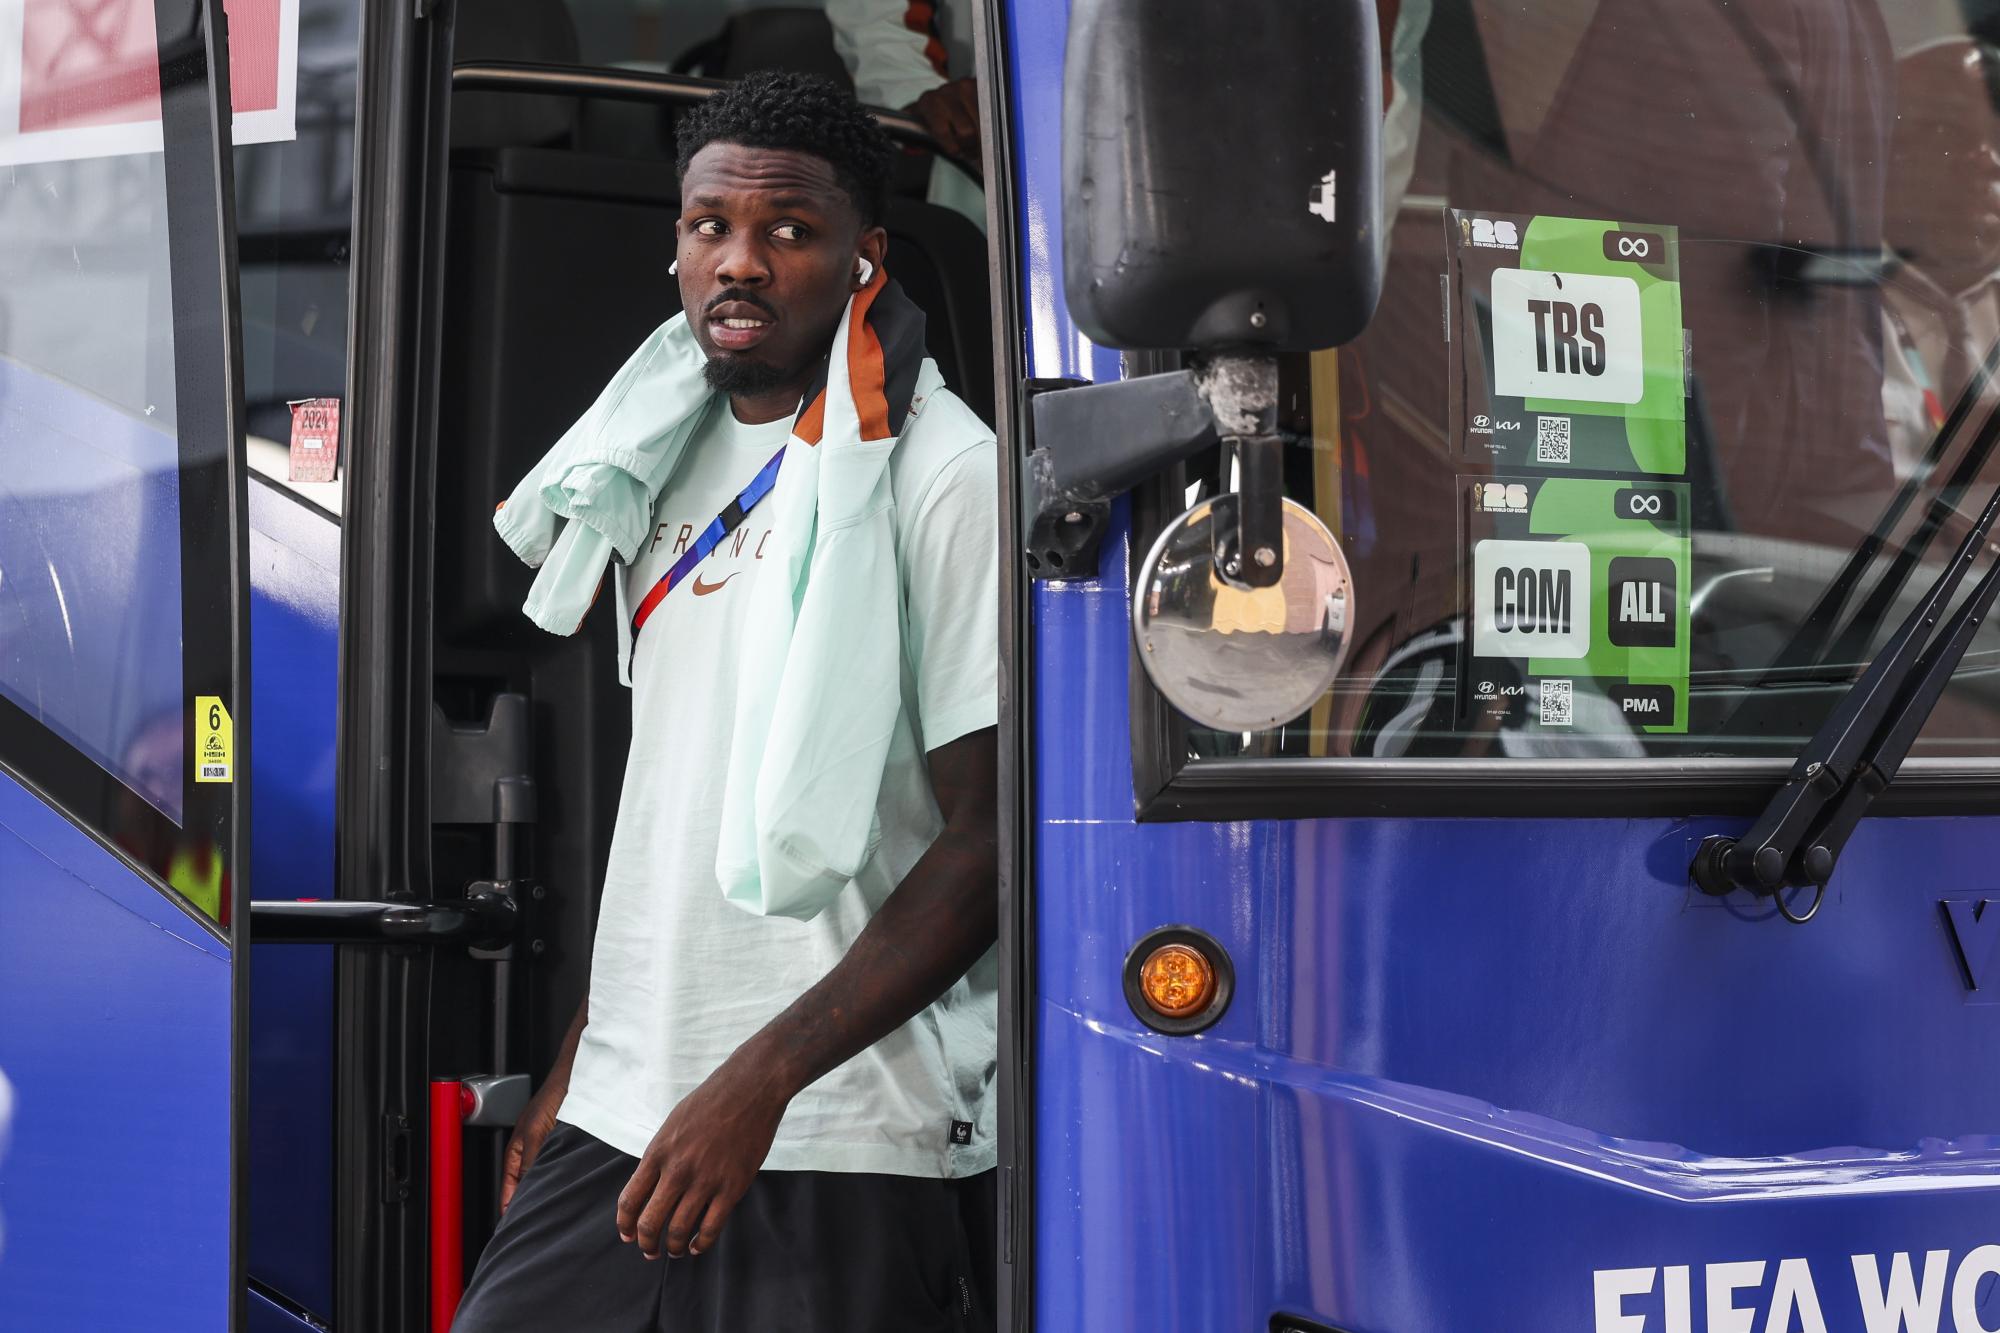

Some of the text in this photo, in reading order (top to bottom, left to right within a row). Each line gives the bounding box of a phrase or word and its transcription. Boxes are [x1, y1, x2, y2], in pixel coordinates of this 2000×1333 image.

[1527, 299, 1606, 377] TRS
[302, 410, 328, 429] 2024
[650, 523, 772, 560] FRNC
[1494, 566, 1571, 634] COM
[1619, 581, 1666, 623] ALL
[209, 704, 221, 731] 6
[1623, 698, 1660, 713] PMA
[1593, 1257, 1828, 1333] FIFA
